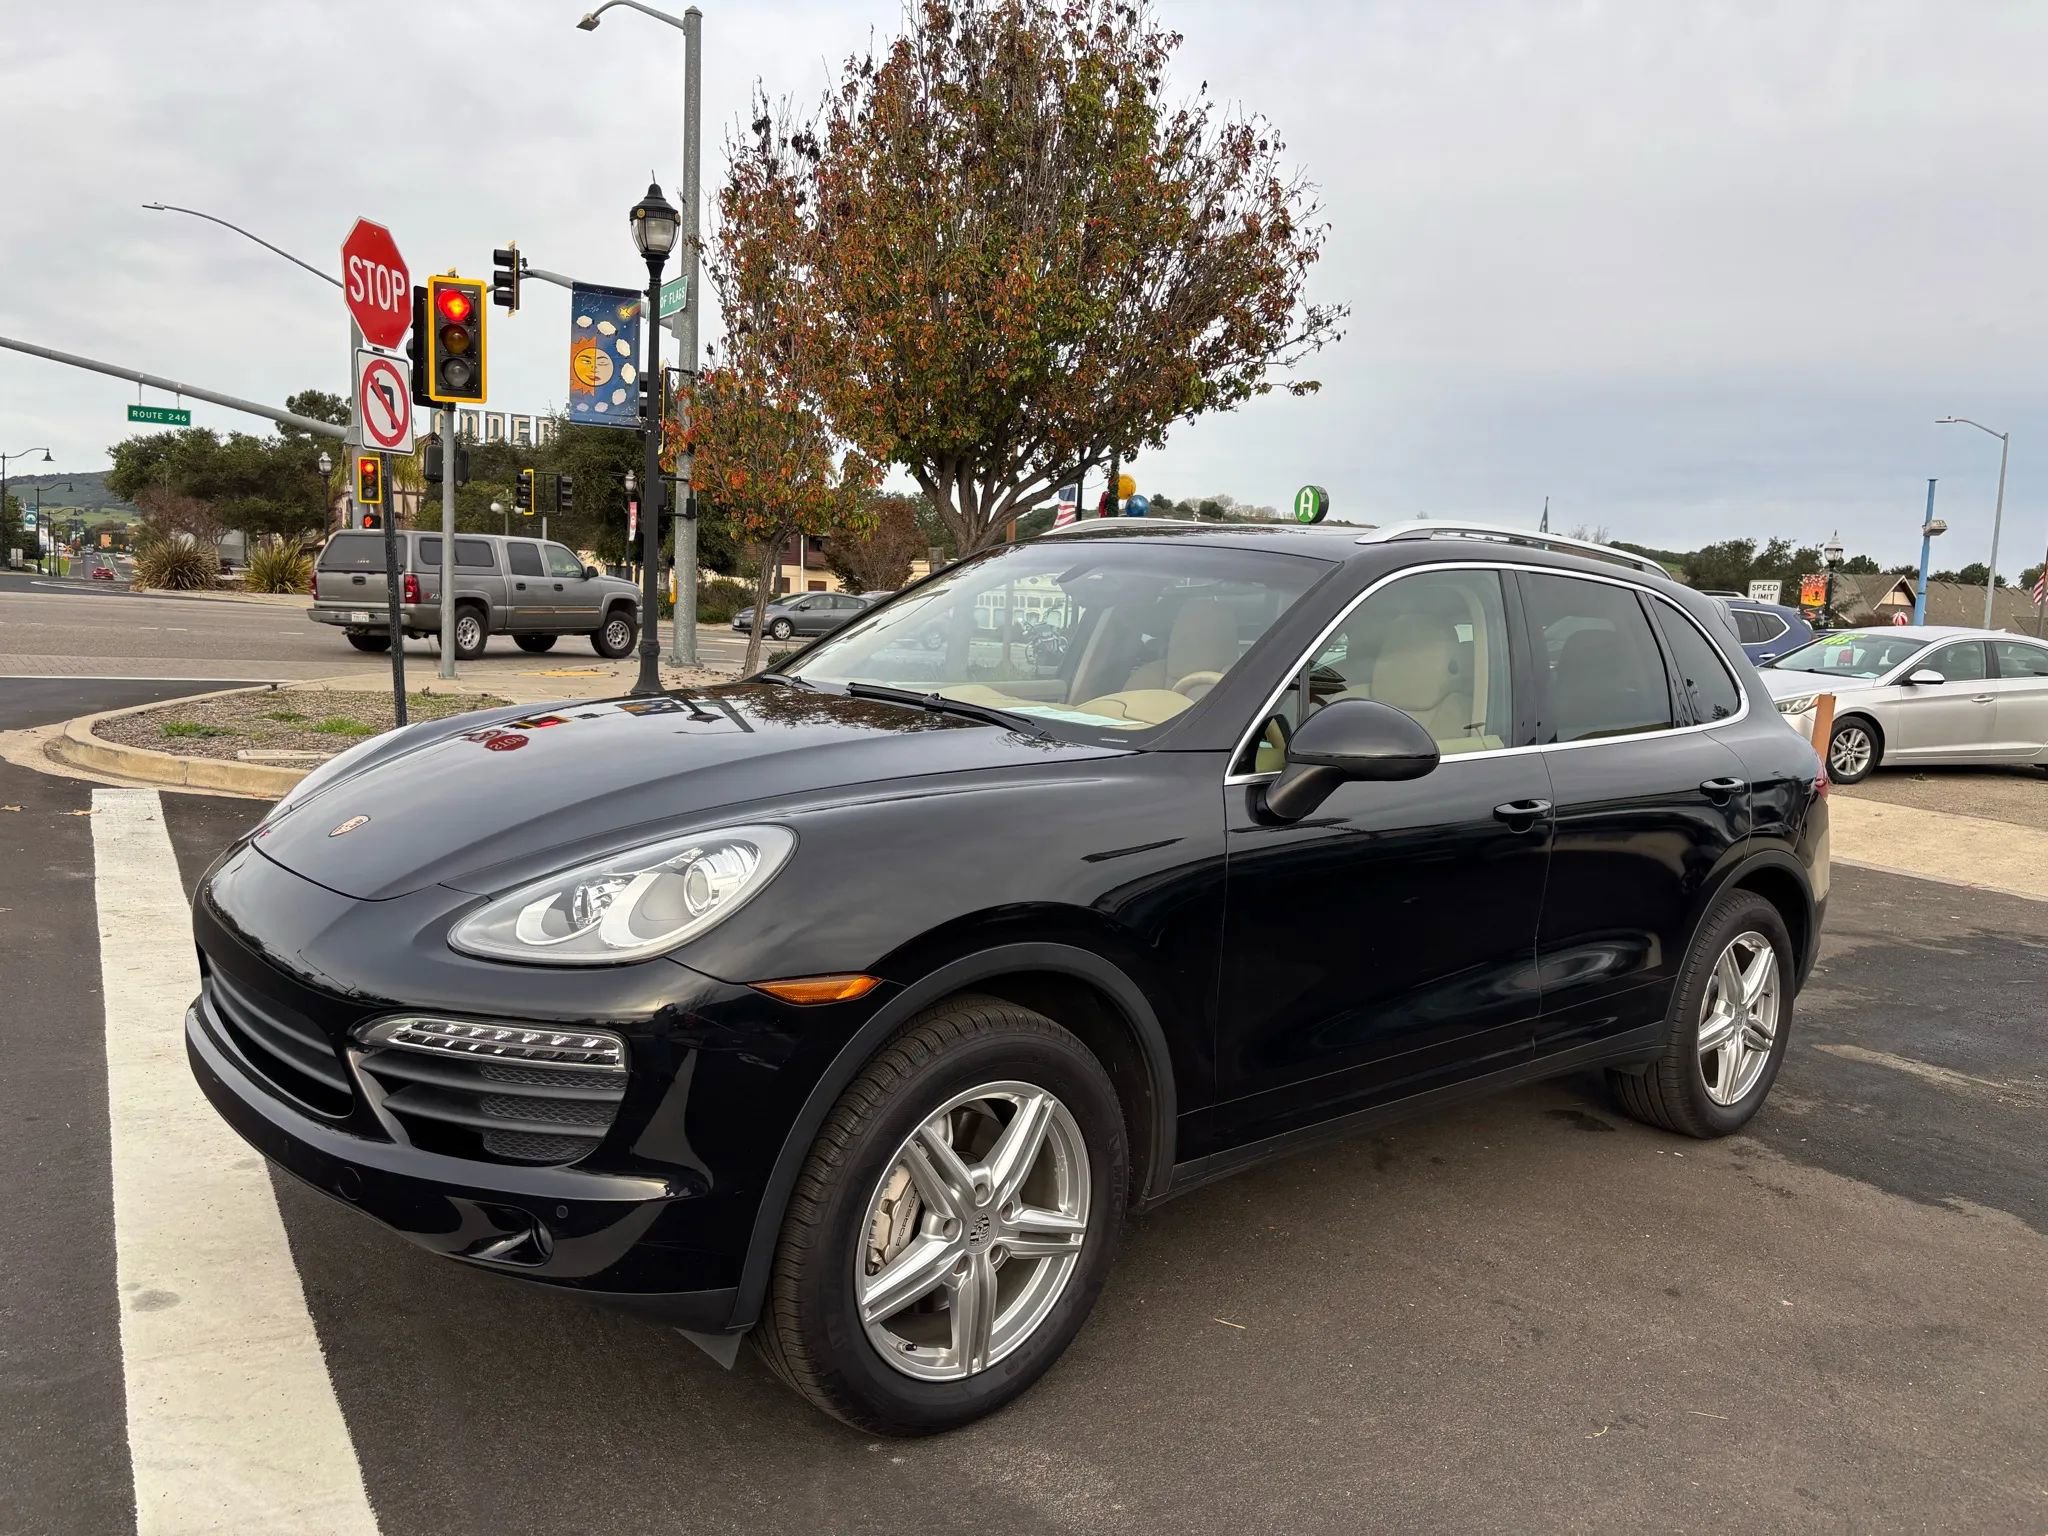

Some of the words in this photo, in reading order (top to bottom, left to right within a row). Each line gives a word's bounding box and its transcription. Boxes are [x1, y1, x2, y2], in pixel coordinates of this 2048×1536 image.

[349, 254, 406, 313] STOP
[669, 286, 686, 305] FLAGS
[132, 410, 164, 420] ROUTE
[168, 413, 187, 422] 246
[1299, 487, 1314, 518] A
[1751, 584, 1779, 592] SPEED
[1752, 593, 1775, 601] LIMIT
[895, 1186, 918, 1247] PORSCH
